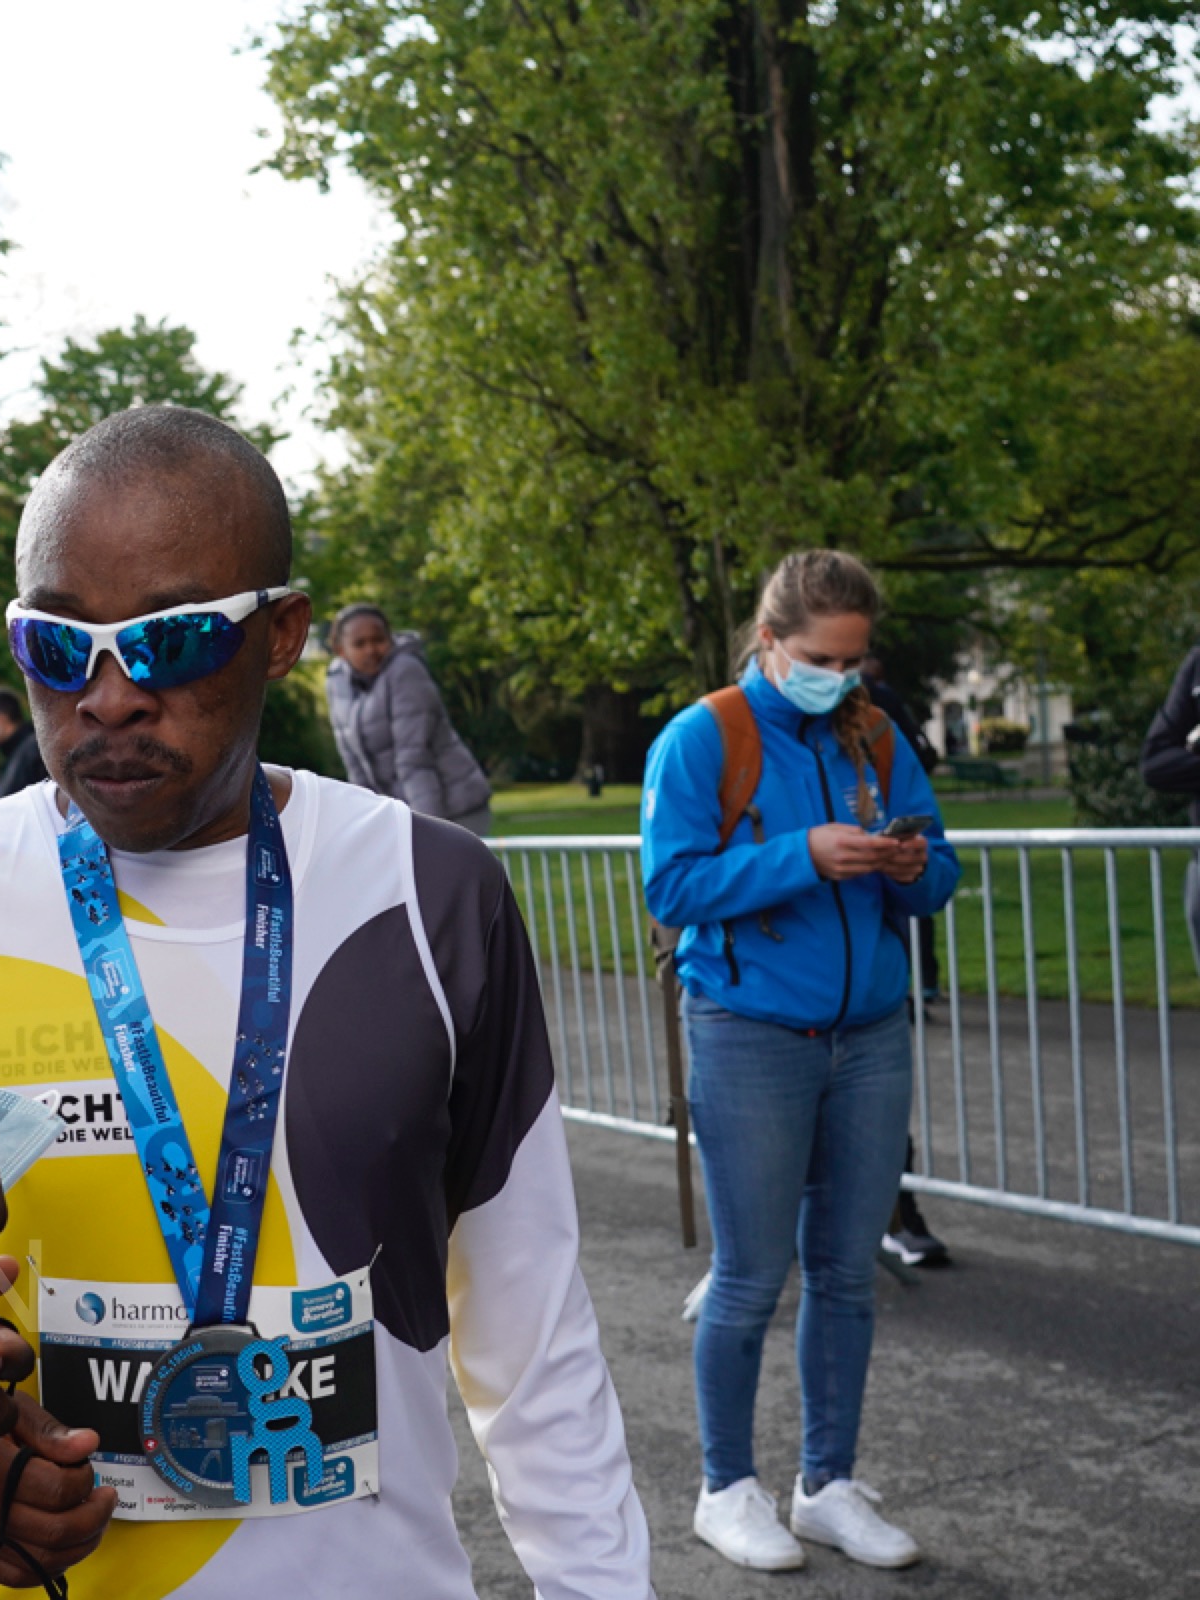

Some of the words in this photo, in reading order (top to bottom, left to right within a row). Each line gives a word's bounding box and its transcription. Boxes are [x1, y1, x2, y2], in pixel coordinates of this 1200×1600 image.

[256, 903, 268, 949] Finisher
[113, 1023, 136, 1073] Finisher
[32, 1060, 65, 1075] DIE
[92, 1126, 135, 1142] WEL
[213, 1225, 232, 1275] Finisher
[111, 1297, 188, 1321] harmo
